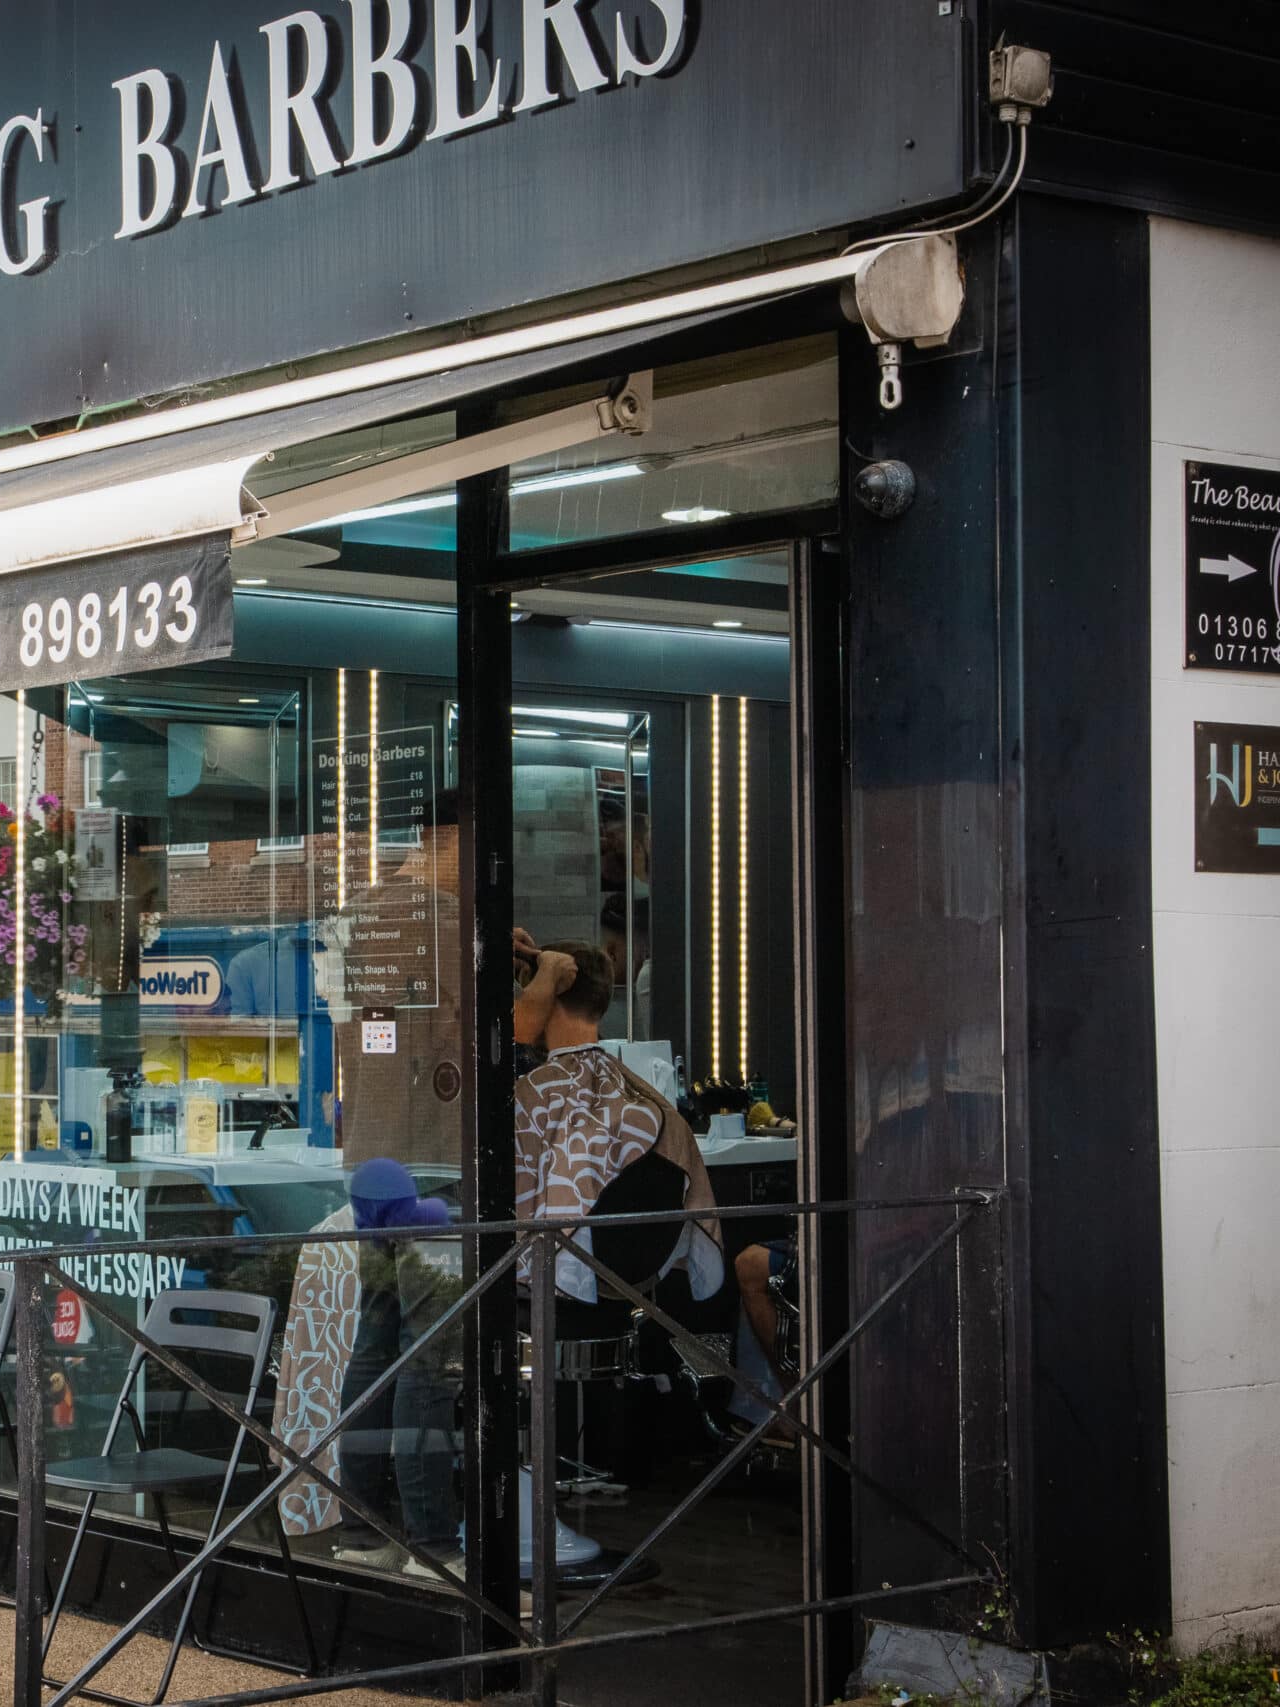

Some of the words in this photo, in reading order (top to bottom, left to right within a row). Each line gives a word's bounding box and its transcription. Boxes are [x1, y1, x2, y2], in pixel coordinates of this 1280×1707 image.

[112, 0, 683, 239] BARBERS
[1191, 478, 1233, 507] The
[20, 576, 198, 667] 898133
[1198, 613, 1268, 640] 01306
[1215, 643, 1270, 665] 07717
[1258, 768, 1269, 784] &
[349, 813, 361, 821] Cut
[323, 881, 351, 891] Chiln
[353, 880, 373, 889] Unde
[355, 931, 370, 940] Hair
[371, 929, 400, 940] Removal
[417, 946, 426, 955] £5
[365, 965, 385, 975] Shape
[354, 982, 385, 993] Finishing
[414, 981, 427, 991] £13
[0, 1175, 50, 1222] DAYS
[58, 1183, 71, 1224] A
[78, 1184, 141, 1233] WEEK
[60, 1253, 185, 1300] NECESSARY
